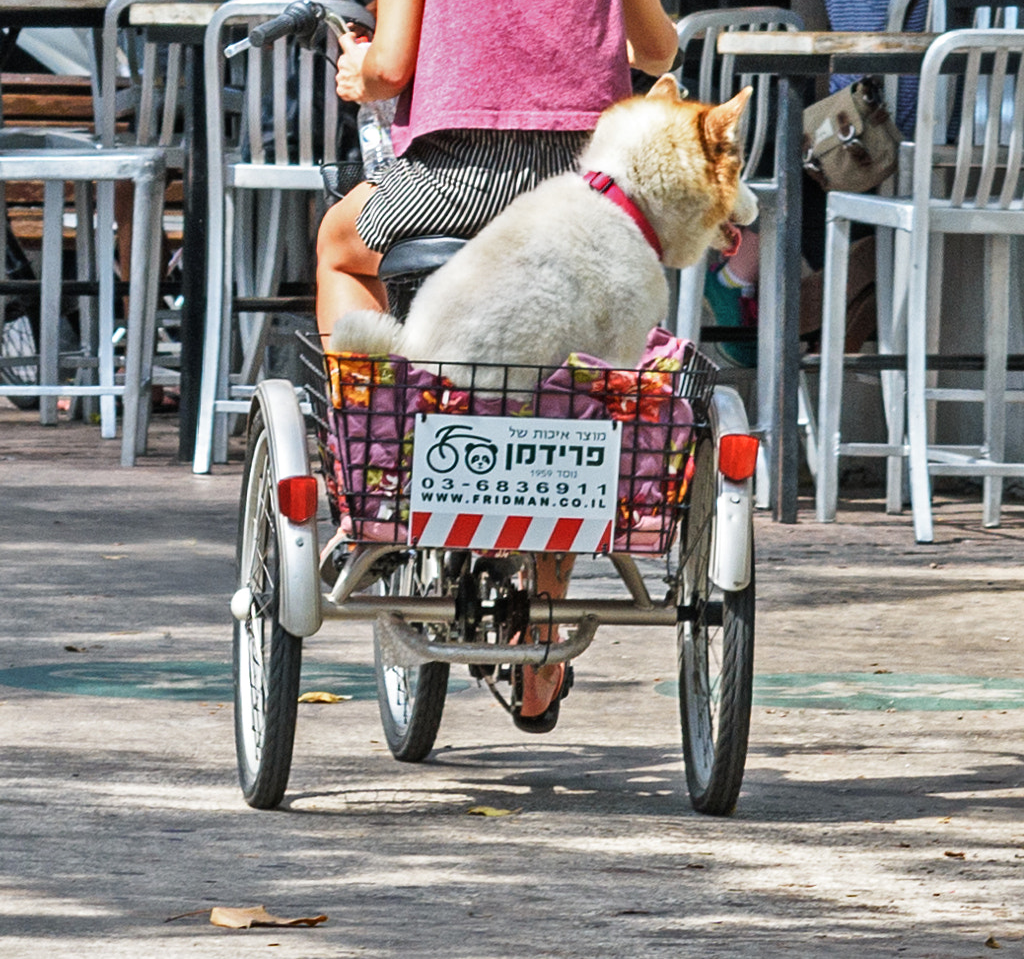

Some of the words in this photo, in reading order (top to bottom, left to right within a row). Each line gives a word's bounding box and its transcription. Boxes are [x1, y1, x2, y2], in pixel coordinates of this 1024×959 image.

[508, 425, 529, 439] של
[532, 428, 571, 441] איכות
[575, 430, 607, 442] מוצר
[505, 442, 606, 471] פרידמן
[421, 476, 607, 496] 03-6836911
[421, 491, 607, 509] WWW.FRIDMAN.CO.IL
